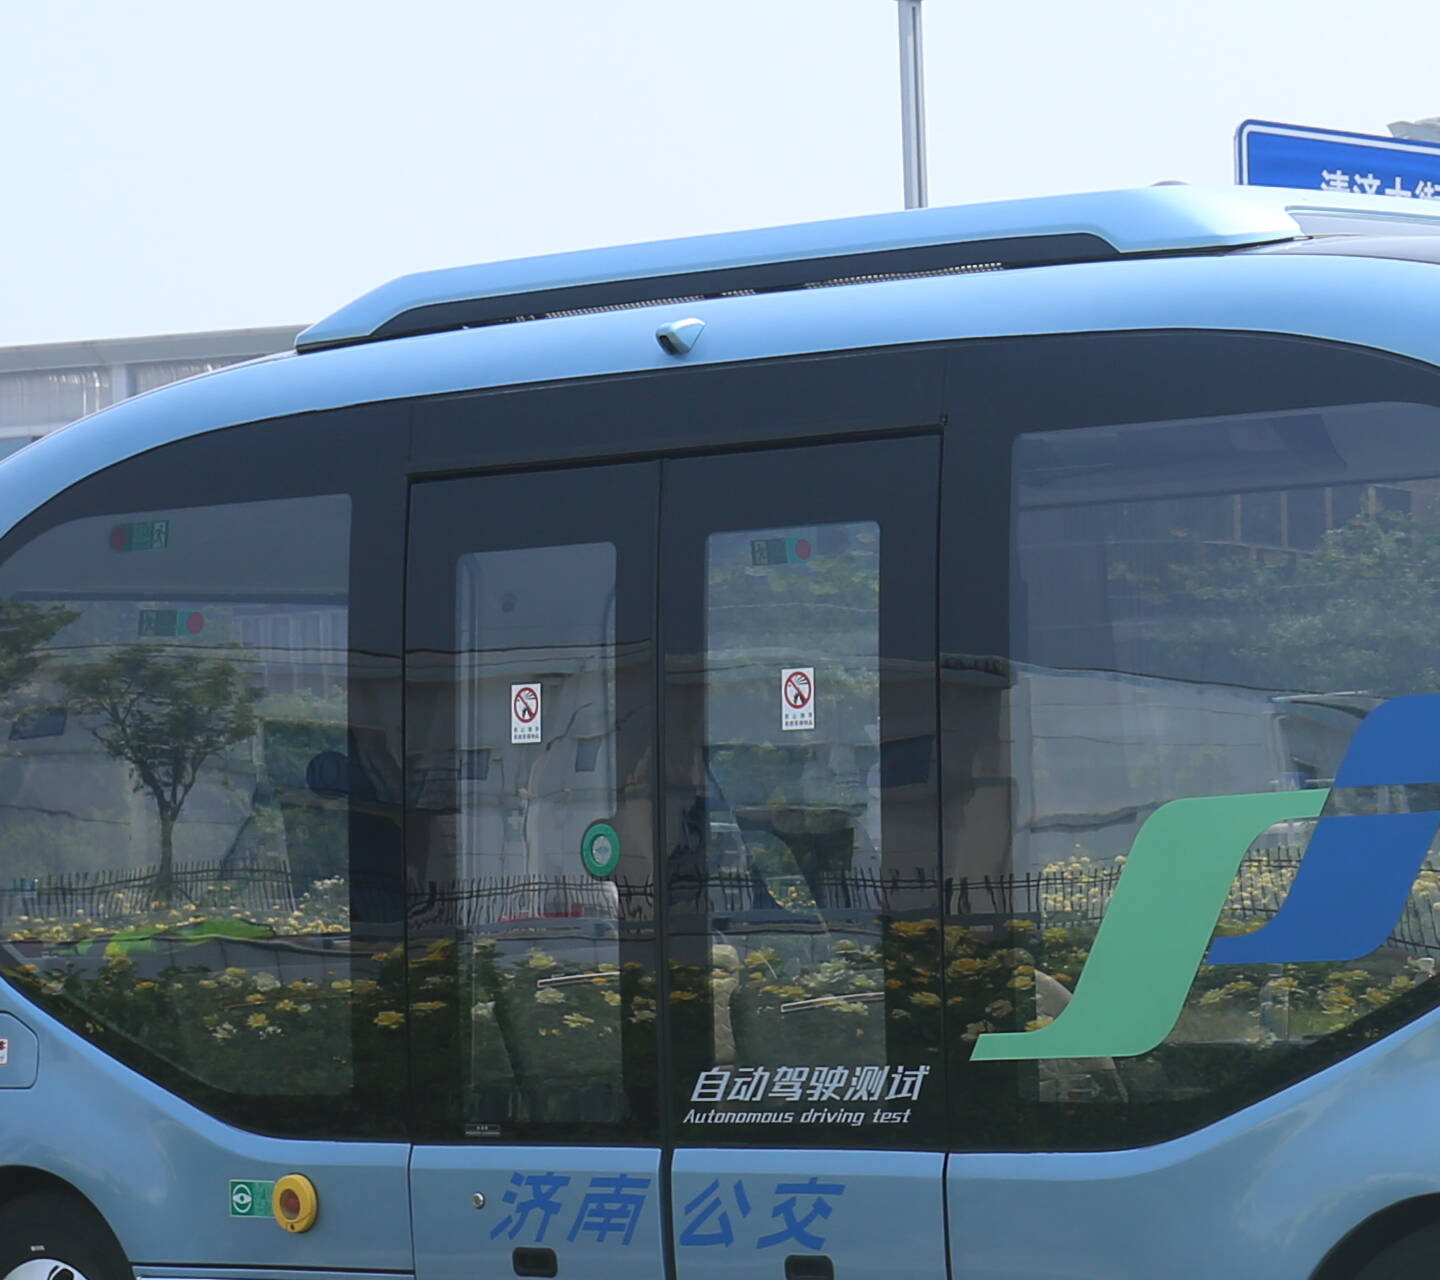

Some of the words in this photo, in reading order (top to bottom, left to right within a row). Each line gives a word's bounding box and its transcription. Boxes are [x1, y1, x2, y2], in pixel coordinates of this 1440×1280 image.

[691, 1065, 930, 1102] 自动驾驶测试
[683, 1108, 795, 1124] Autonomous
[800, 1107, 865, 1126] driving
[873, 1108, 912, 1124] test
[490, 1171, 846, 1251] 济南公交
